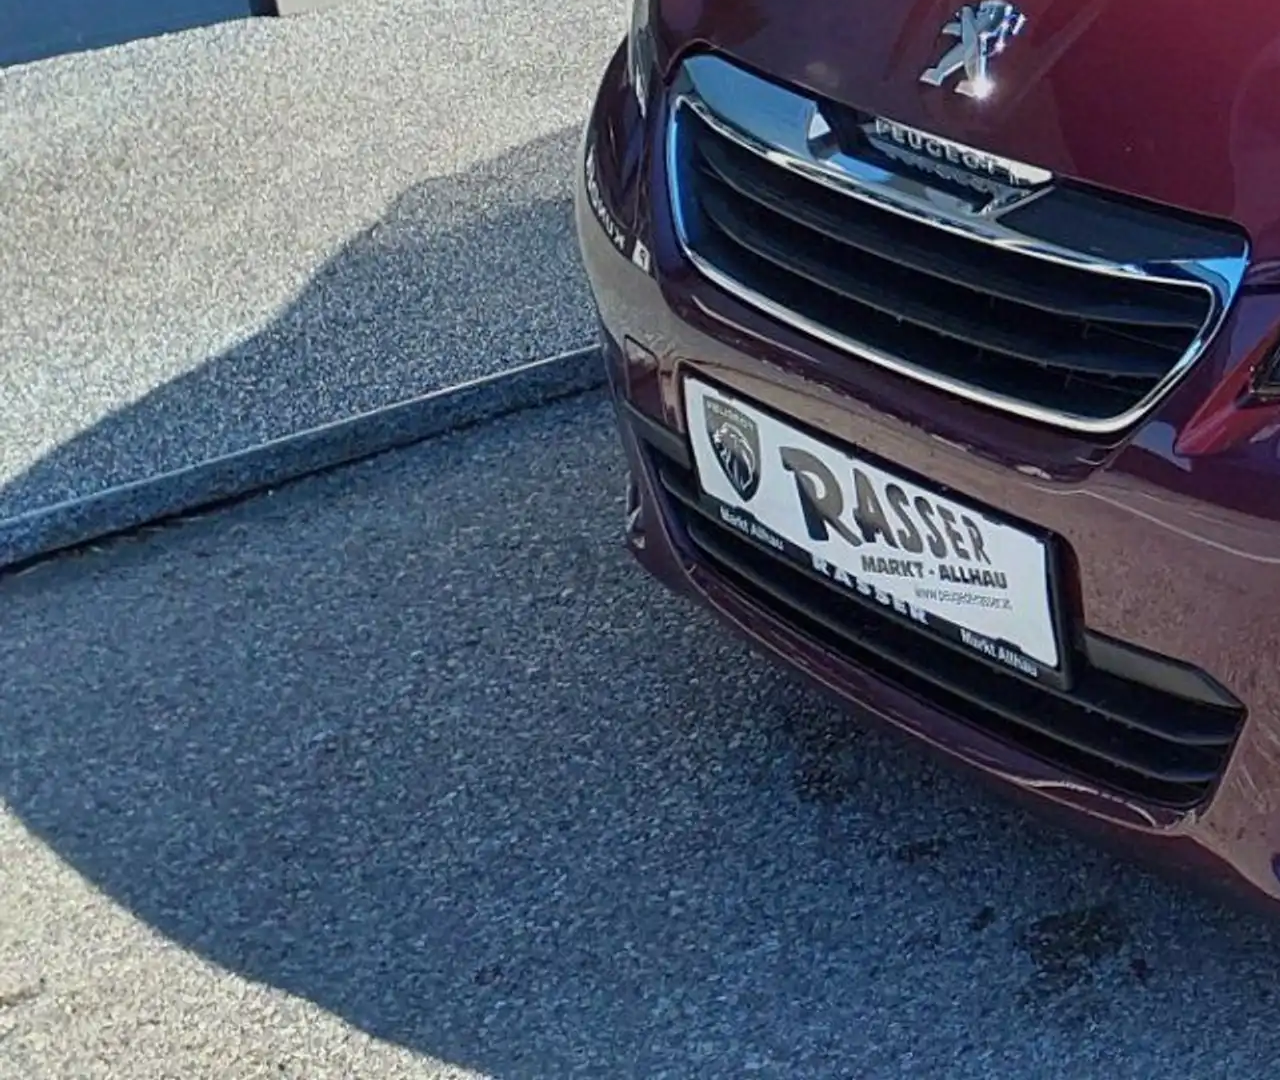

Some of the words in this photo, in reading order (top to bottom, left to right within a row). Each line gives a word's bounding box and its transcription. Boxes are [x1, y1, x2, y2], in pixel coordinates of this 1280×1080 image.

[875, 118, 1000, 173] PEUGEOT
[779, 446, 991, 565] RASSER
[812, 552, 929, 625] RASSER
[861, 555, 924, 578] MARKT
[938, 564, 1008, 589] ALLHAU
[960, 628, 997, 658] Markt
[998, 646, 1038, 678] Allhau
